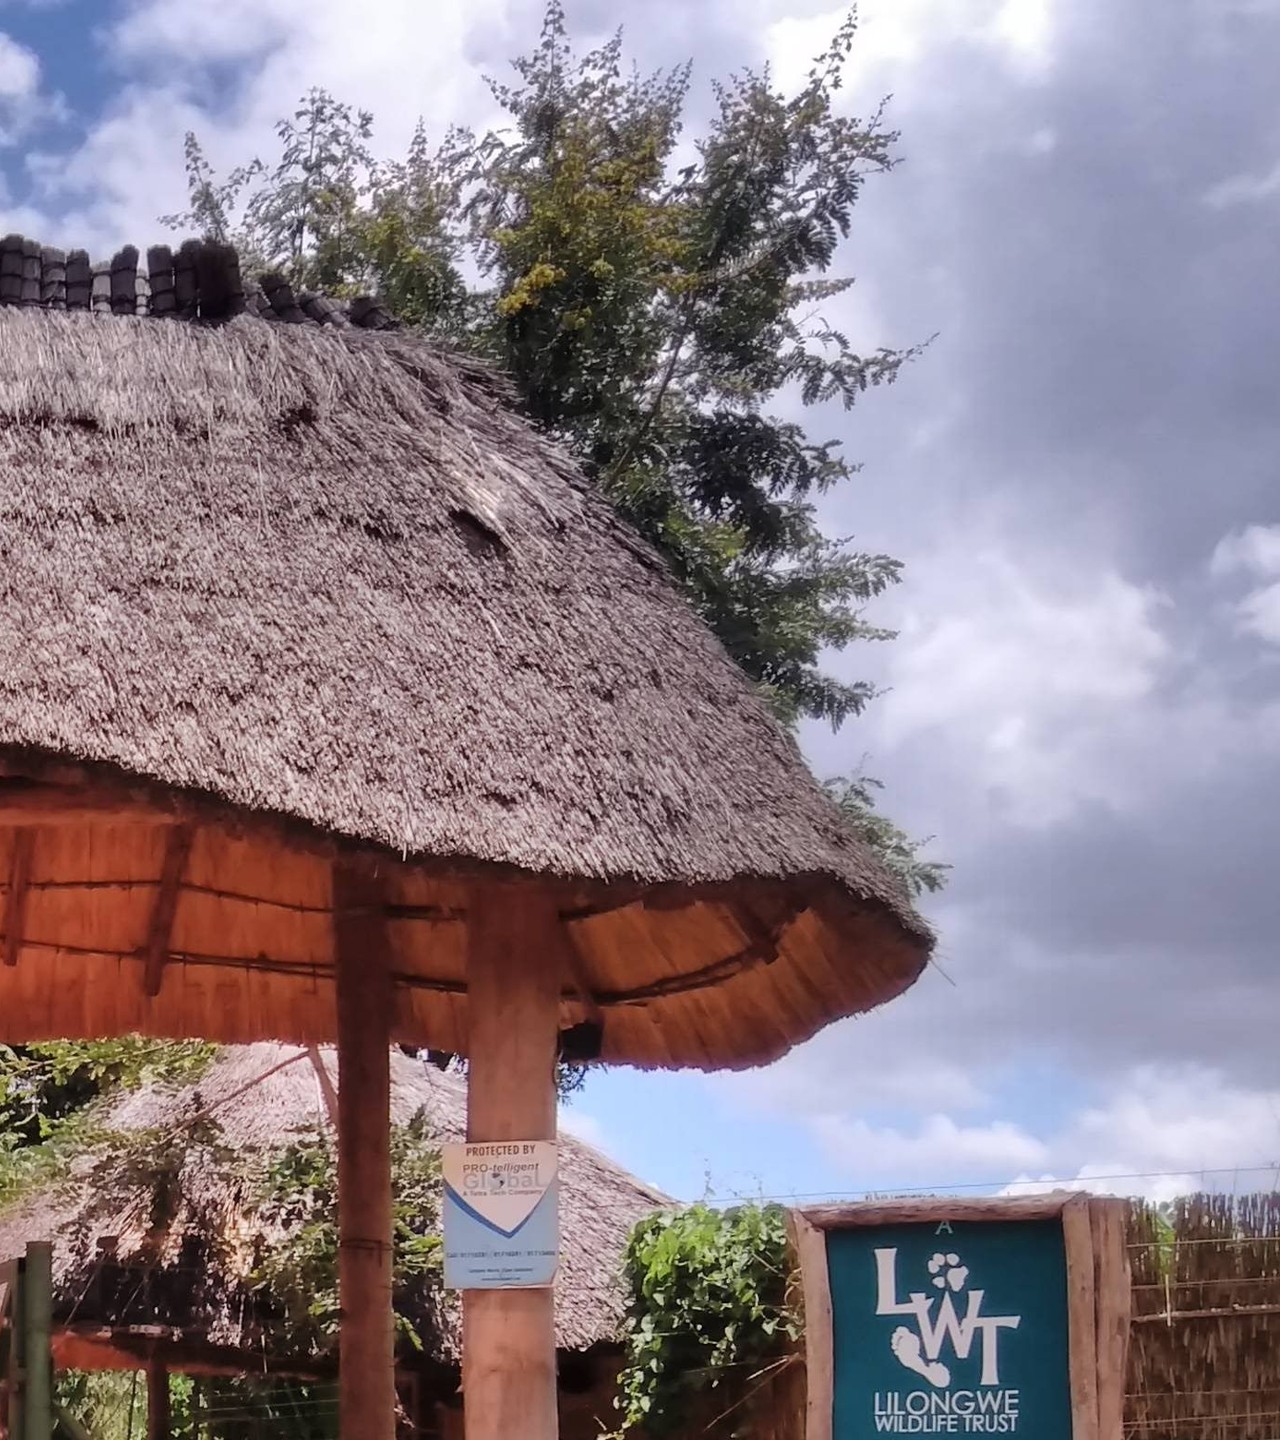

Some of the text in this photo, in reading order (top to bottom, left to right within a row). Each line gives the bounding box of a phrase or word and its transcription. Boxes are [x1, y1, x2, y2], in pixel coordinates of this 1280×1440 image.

[466, 1144, 536, 1157] PROTECTED BY
[934, 1219, 954, 1235] A
[873, 1246, 1021, 1387] LWT
[873, 1389, 1020, 1416] LILONGWE
[874, 1414, 1019, 1434] WILDLIFE TRUST
